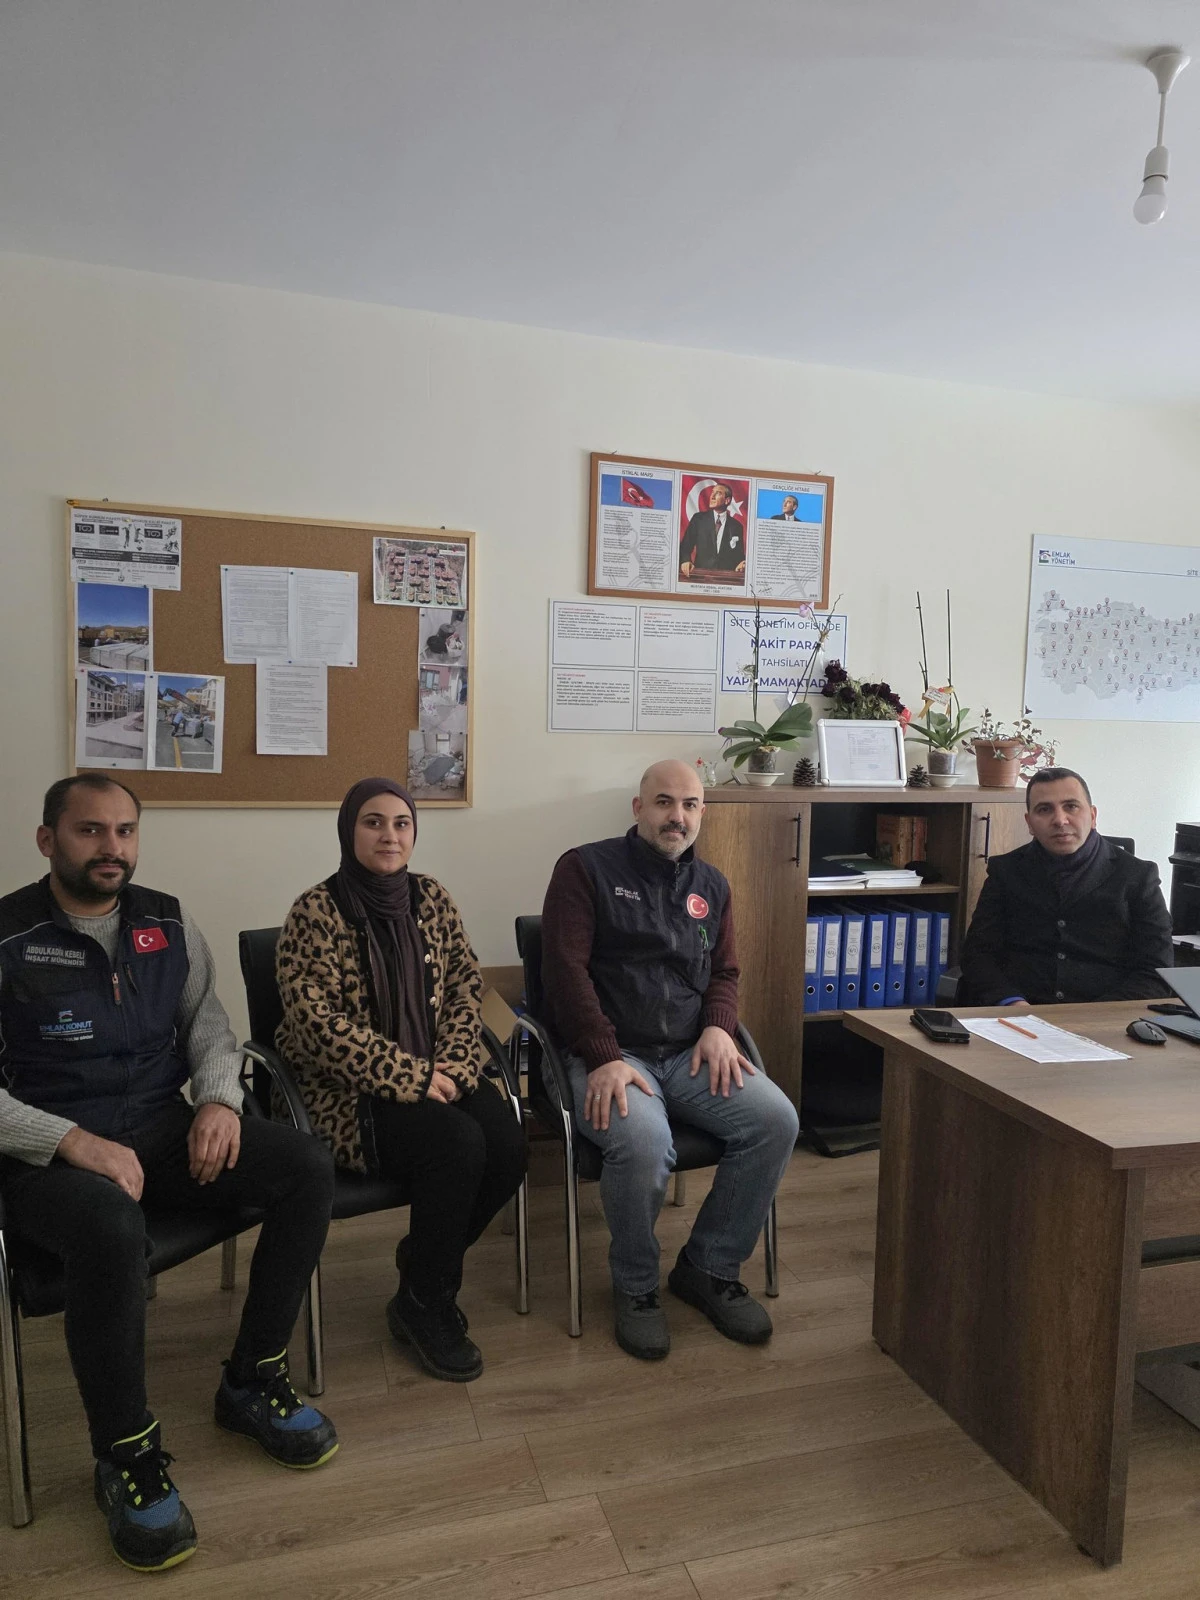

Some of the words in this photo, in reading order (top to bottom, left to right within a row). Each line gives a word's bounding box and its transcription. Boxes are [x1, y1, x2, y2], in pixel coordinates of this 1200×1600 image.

[730, 617, 750, 627] SİTE
[753, 618, 795, 629] YÖNETİM
[797, 619, 841, 631] OFİSİNDE
[750, 637, 786, 649] NAKİT
[66, 1020, 93, 1030] KONUT
